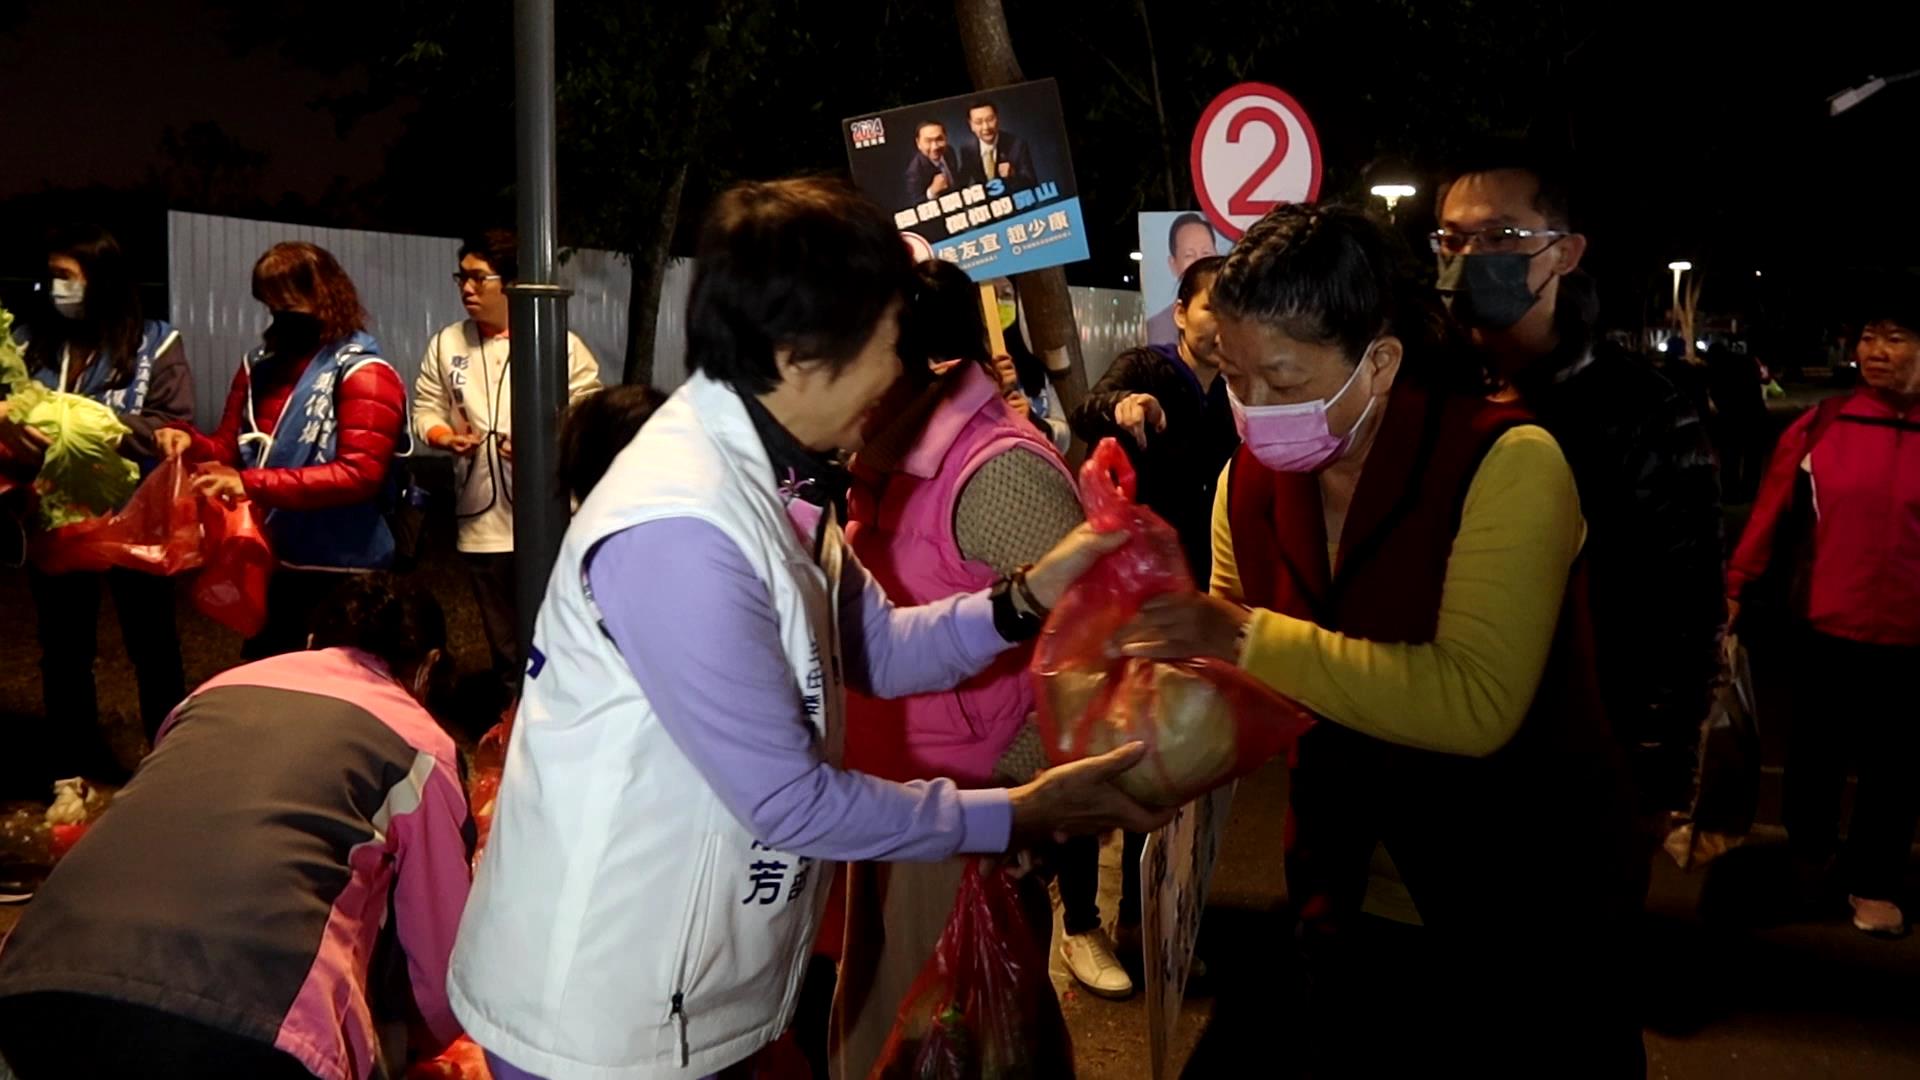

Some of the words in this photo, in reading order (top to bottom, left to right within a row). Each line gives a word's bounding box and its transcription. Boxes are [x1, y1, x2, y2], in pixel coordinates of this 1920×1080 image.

[1226, 106, 1289, 216] 2
[1007, 211, 1069, 245] 趙少康
[742, 841, 788, 905] 芳
